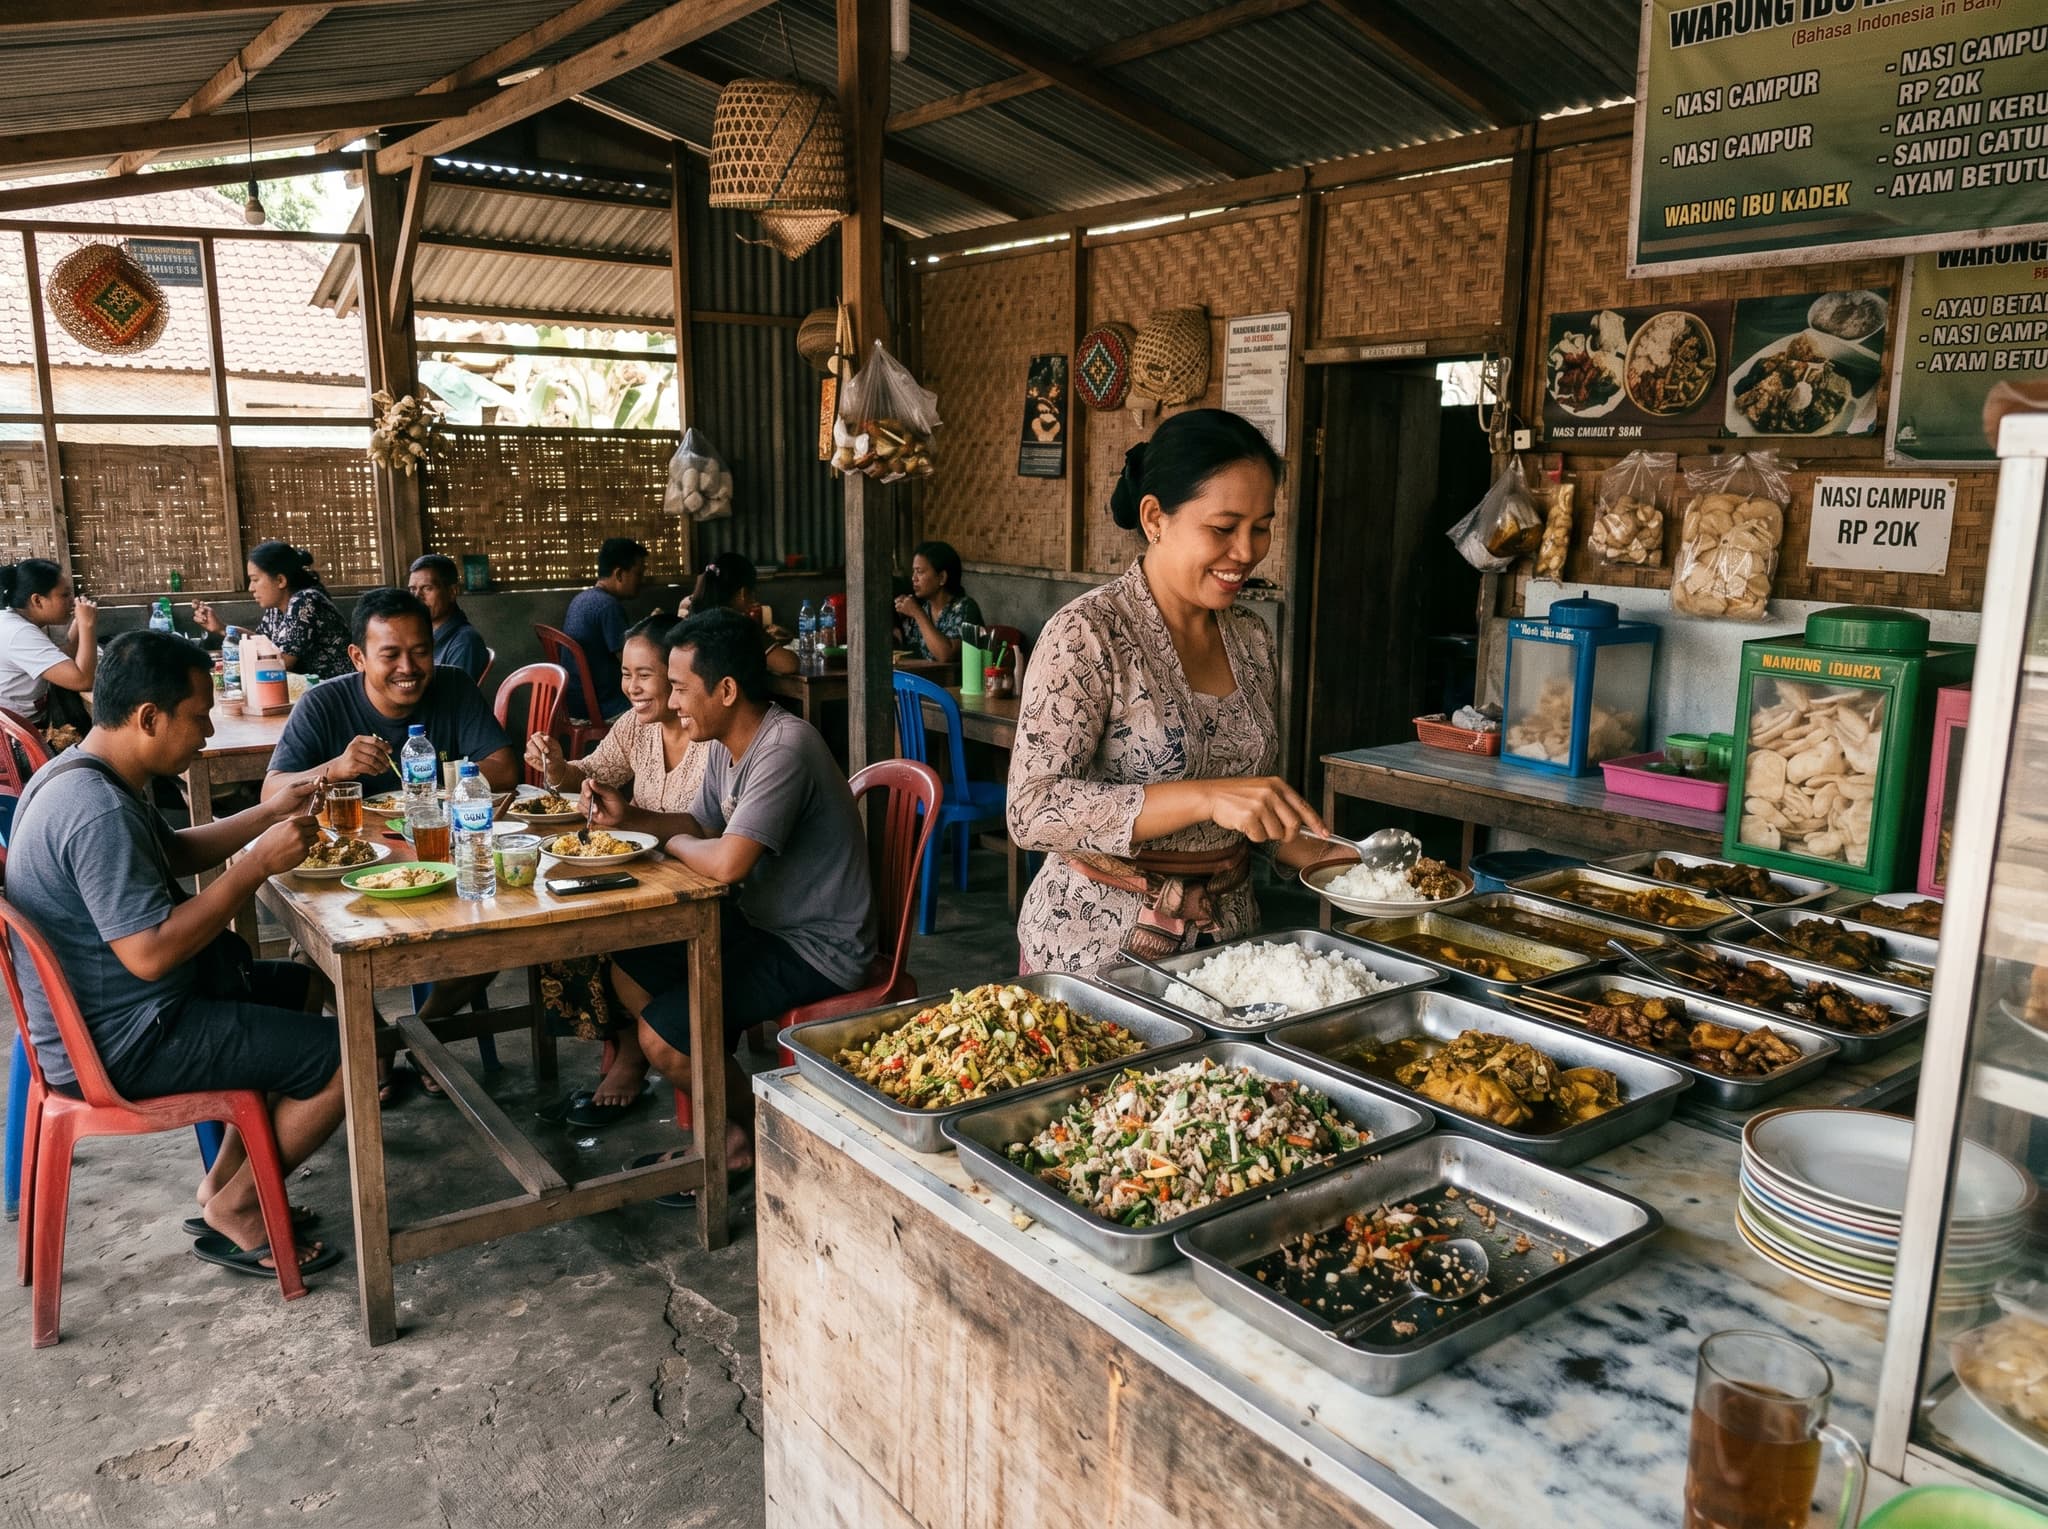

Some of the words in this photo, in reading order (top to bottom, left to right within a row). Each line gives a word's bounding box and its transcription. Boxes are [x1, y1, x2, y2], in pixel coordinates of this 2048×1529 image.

[1670, 0, 1796, 48] WARUNG
[1792, 23, 1852, 48] (Bahasa
[1857, 4, 1935, 32] Indonesia
[1940, 0, 1956, 17] in
[1900, 43, 1956, 75] NASI
[1675, 88, 1723, 118] NASI
[1728, 70, 1820, 109] CAMPUR
[1898, 80, 1930, 107] RP
[1936, 69, 1984, 100] 20K
[1895, 103, 1981, 136] KARANI
[1672, 139, 1719, 168] NASI
[1723, 125, 1813, 160] CAMPUR
[1893, 134, 1972, 166] SANIDI
[1889, 168, 1955, 198] AYAM
[1665, 197, 1736, 227] WARUNG
[1742, 191, 1776, 217] IBU
[1781, 182, 1851, 212] KADEK
[1934, 296, 1987, 319] AYAU
[1991, 293, 2048, 316] BETA
[1932, 324, 1981, 346] NASI
[1985, 321, 2048, 343] CAMP
[1929, 351, 1988, 372] AYAM
[1820, 487, 1862, 508] NASI
[1867, 487, 1947, 510] CAMPUR
[1838, 519, 1868, 545] RP
[1873, 520, 1920, 547] 20K
